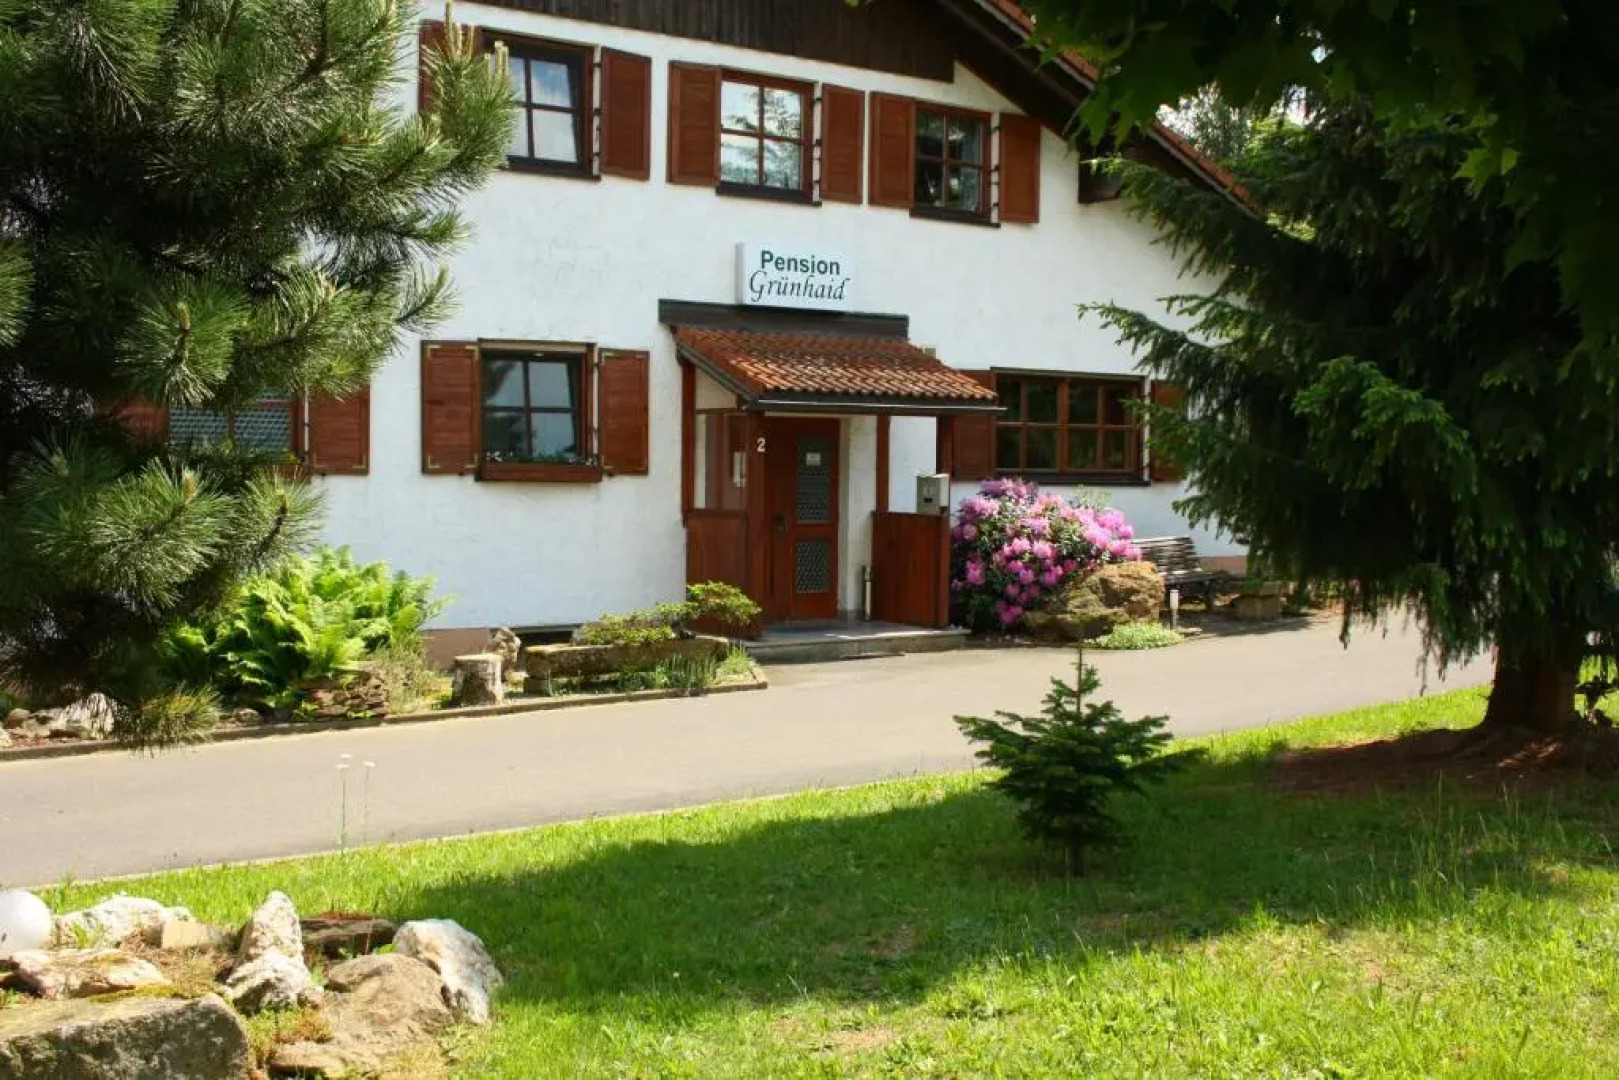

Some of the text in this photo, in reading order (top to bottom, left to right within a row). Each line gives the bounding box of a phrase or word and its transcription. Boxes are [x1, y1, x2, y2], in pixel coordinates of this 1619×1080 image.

[761, 250, 841, 275] Pension
[750, 270, 851, 302] Grünhaid
[756, 437, 766, 453] 2
